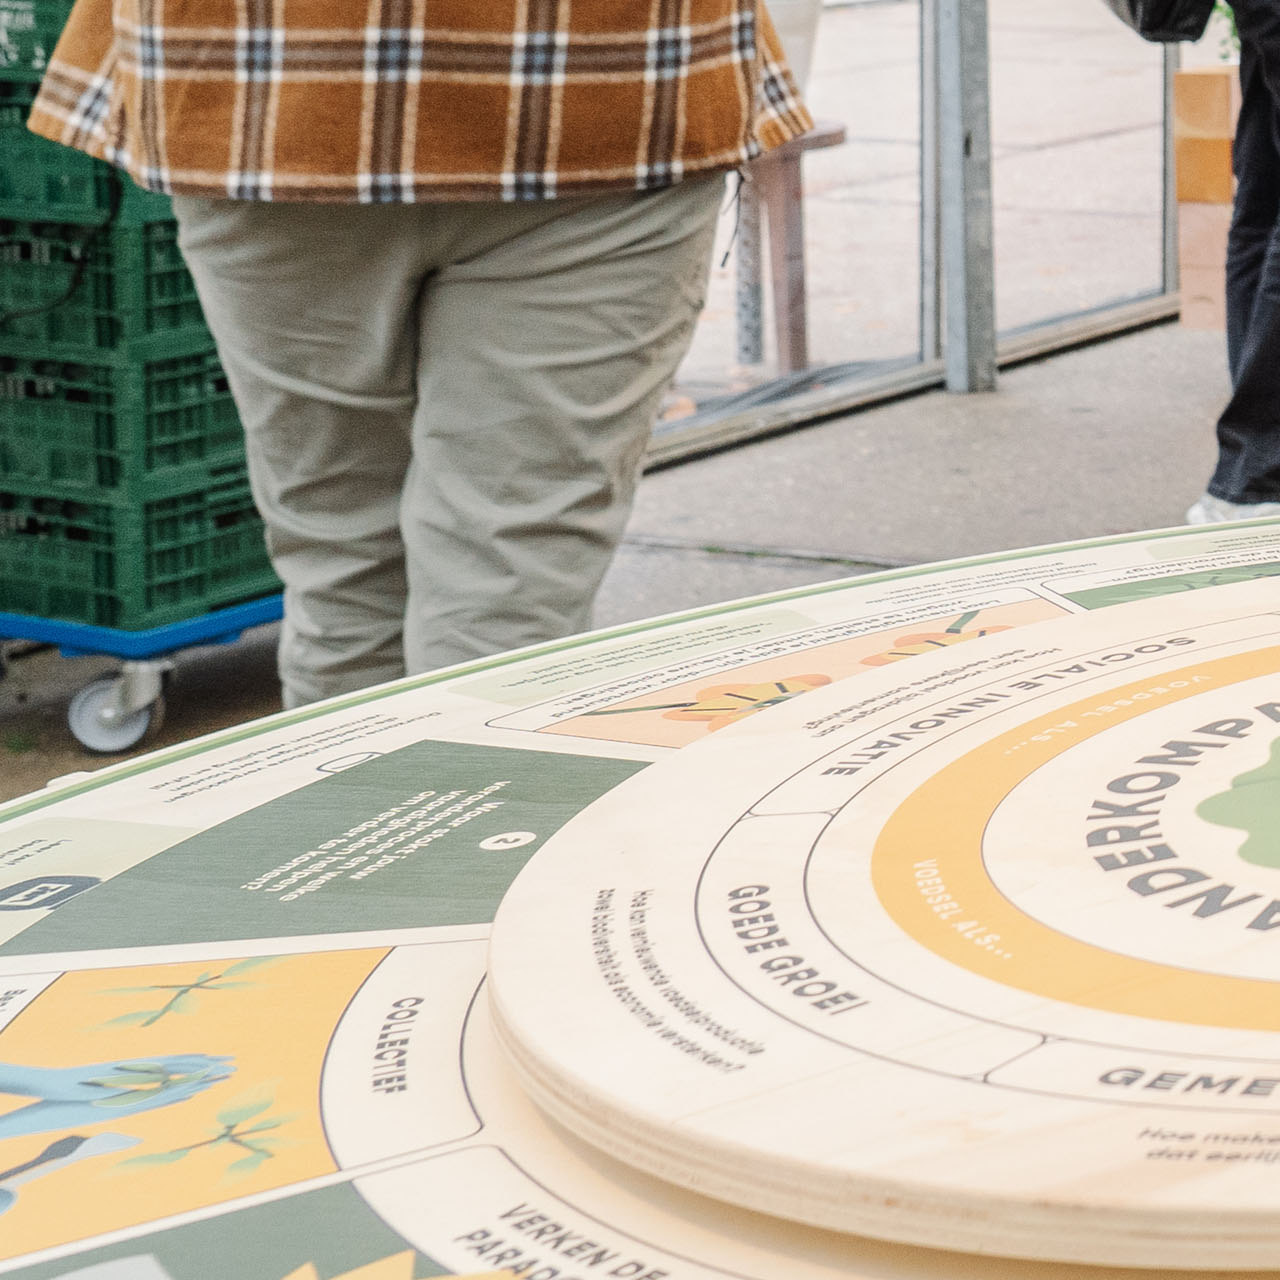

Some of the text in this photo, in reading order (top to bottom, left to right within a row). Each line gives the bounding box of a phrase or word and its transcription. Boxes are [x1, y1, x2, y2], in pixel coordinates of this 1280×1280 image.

[820, 636, 1197, 775] SOCIALE INNOVATIE
[264, 789, 467, 892] vaardigheden helpen
[279, 780, 512, 903] veranderproces en welke
[342, 805, 405, 838] verder
[348, 800, 505, 881] Waar stokt jouw
[401, 789, 436, 806] om
[240, 849, 323, 891] komen?
[913, 859, 1017, 959] VOEDSEL ALS...
[728, 884, 869, 1016] GOEDE GROEI
[372, 997, 424, 1094] COLLECTIEF
[454, 1229, 584, 1280] PARADO
[498, 1202, 621, 1269] VERKEN
